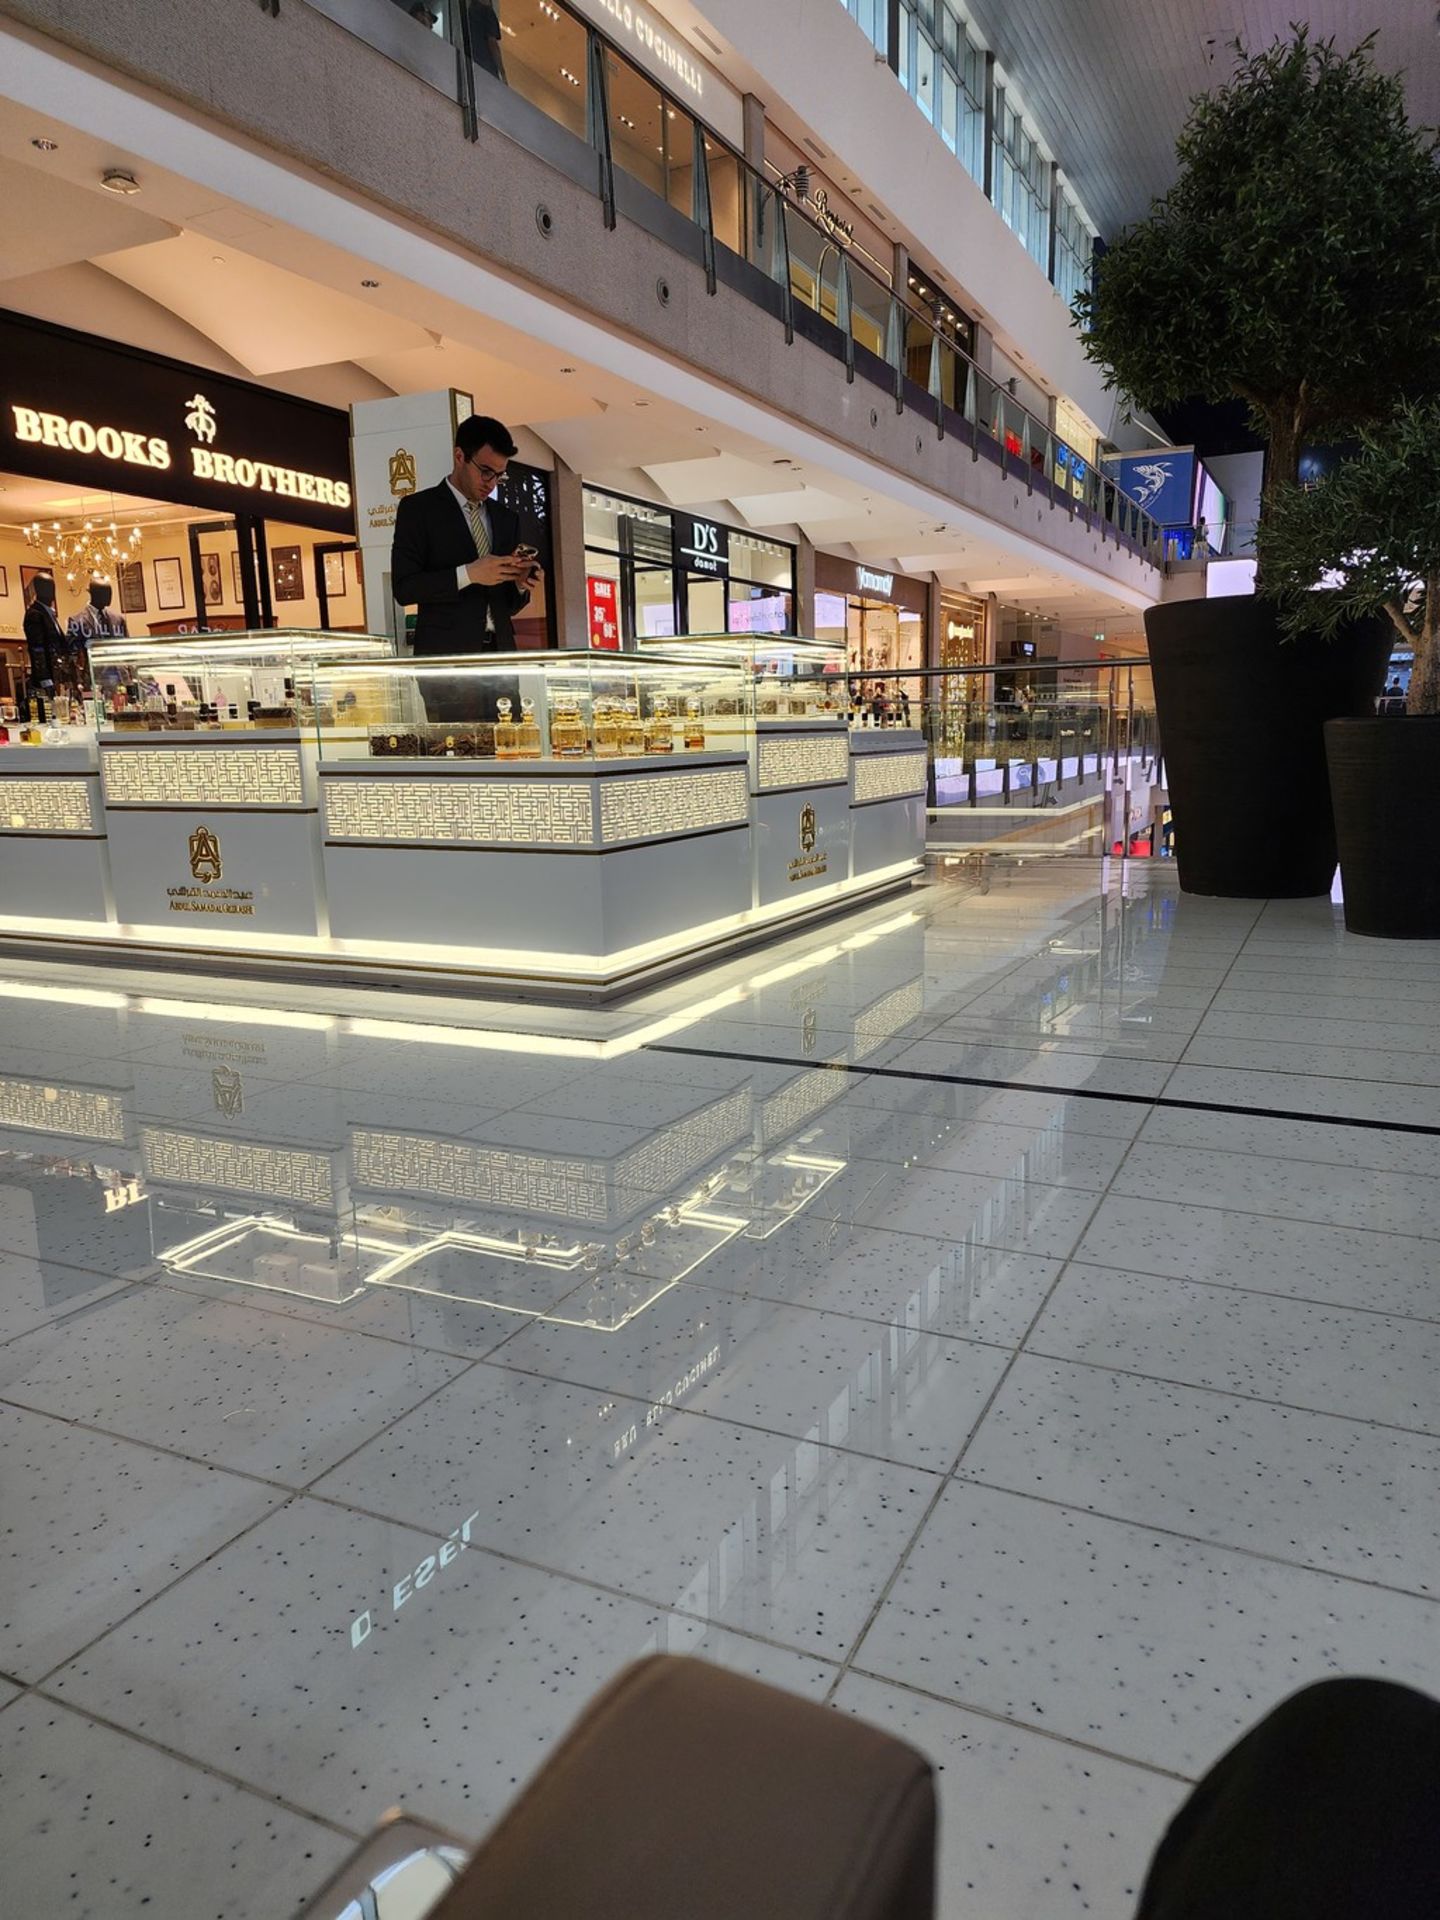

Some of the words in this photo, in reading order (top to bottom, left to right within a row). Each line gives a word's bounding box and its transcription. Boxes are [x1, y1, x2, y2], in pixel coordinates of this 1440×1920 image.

[636, 16, 702, 96] CUCINELLI
[11, 405, 172, 470] BROOKS
[191, 447, 352, 509] BROTHERS
[693, 522, 718, 554] D'S
[594, 581, 612, 599] SALE
